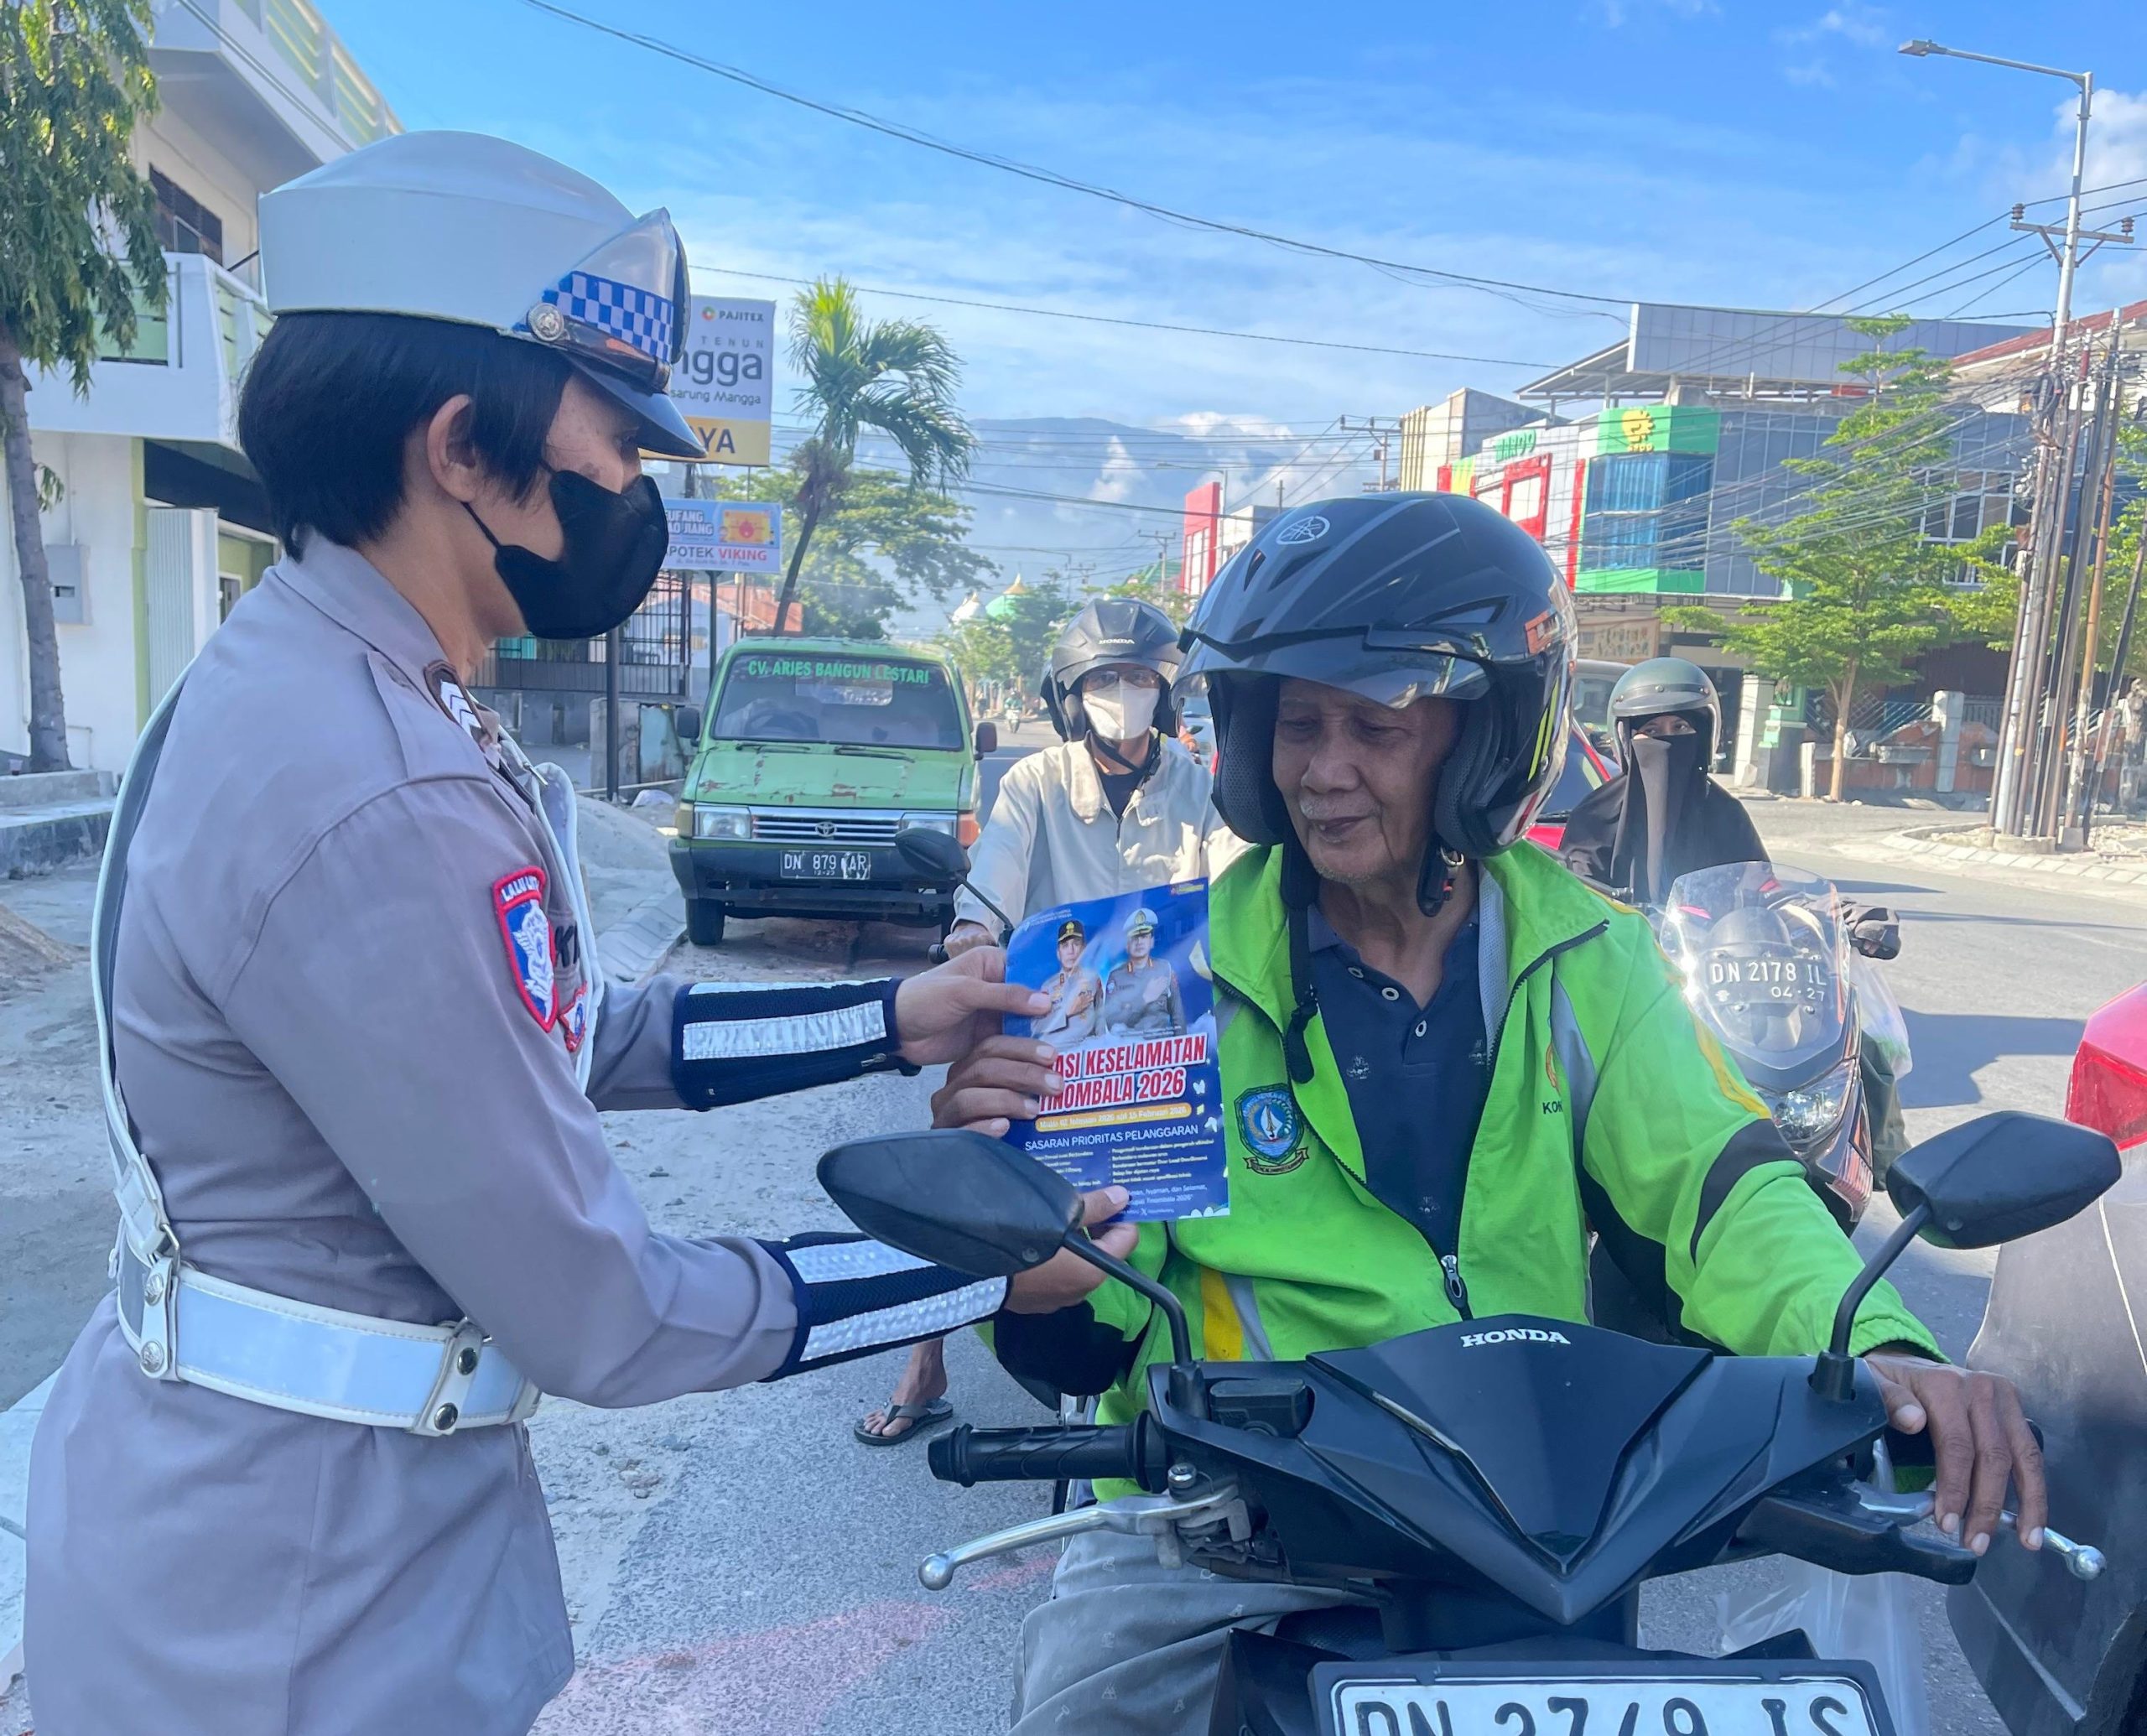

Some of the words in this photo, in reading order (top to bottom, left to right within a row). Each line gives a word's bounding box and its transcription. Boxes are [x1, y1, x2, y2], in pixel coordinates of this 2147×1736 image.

[720, 310, 764, 322] PAJITEX
[670, 389, 710, 403] sarung
[715, 392, 762, 406] Mangga
[684, 522, 713, 536] JIANG
[667, 545, 715, 559] POTEK
[718, 548, 767, 561] VIKING
[748, 660, 768, 676] CV.
[772, 661, 811, 676] ARIES
[815, 662, 871, 678] BANGUN
[875, 665, 929, 684] LESTARI
[784, 854, 802, 870] DN
[813, 855, 836, 870] 879
[1712, 962, 1741, 984] DN
[1748, 961, 1797, 983] 2178
[1807, 964, 1827, 986] IL
[1052, 1052, 1080, 1079] ASI
[1085, 1035, 1206, 1076] KESELAMATAN
[1138, 1069, 1184, 1099] 2026
[1025, 1138, 1070, 1151] SASARAN
[1072, 1133, 1124, 1146] PRIORITAS
[1125, 1125, 1198, 1141] PELANGGARAN
[1461, 1328, 1572, 1348] HONDA
